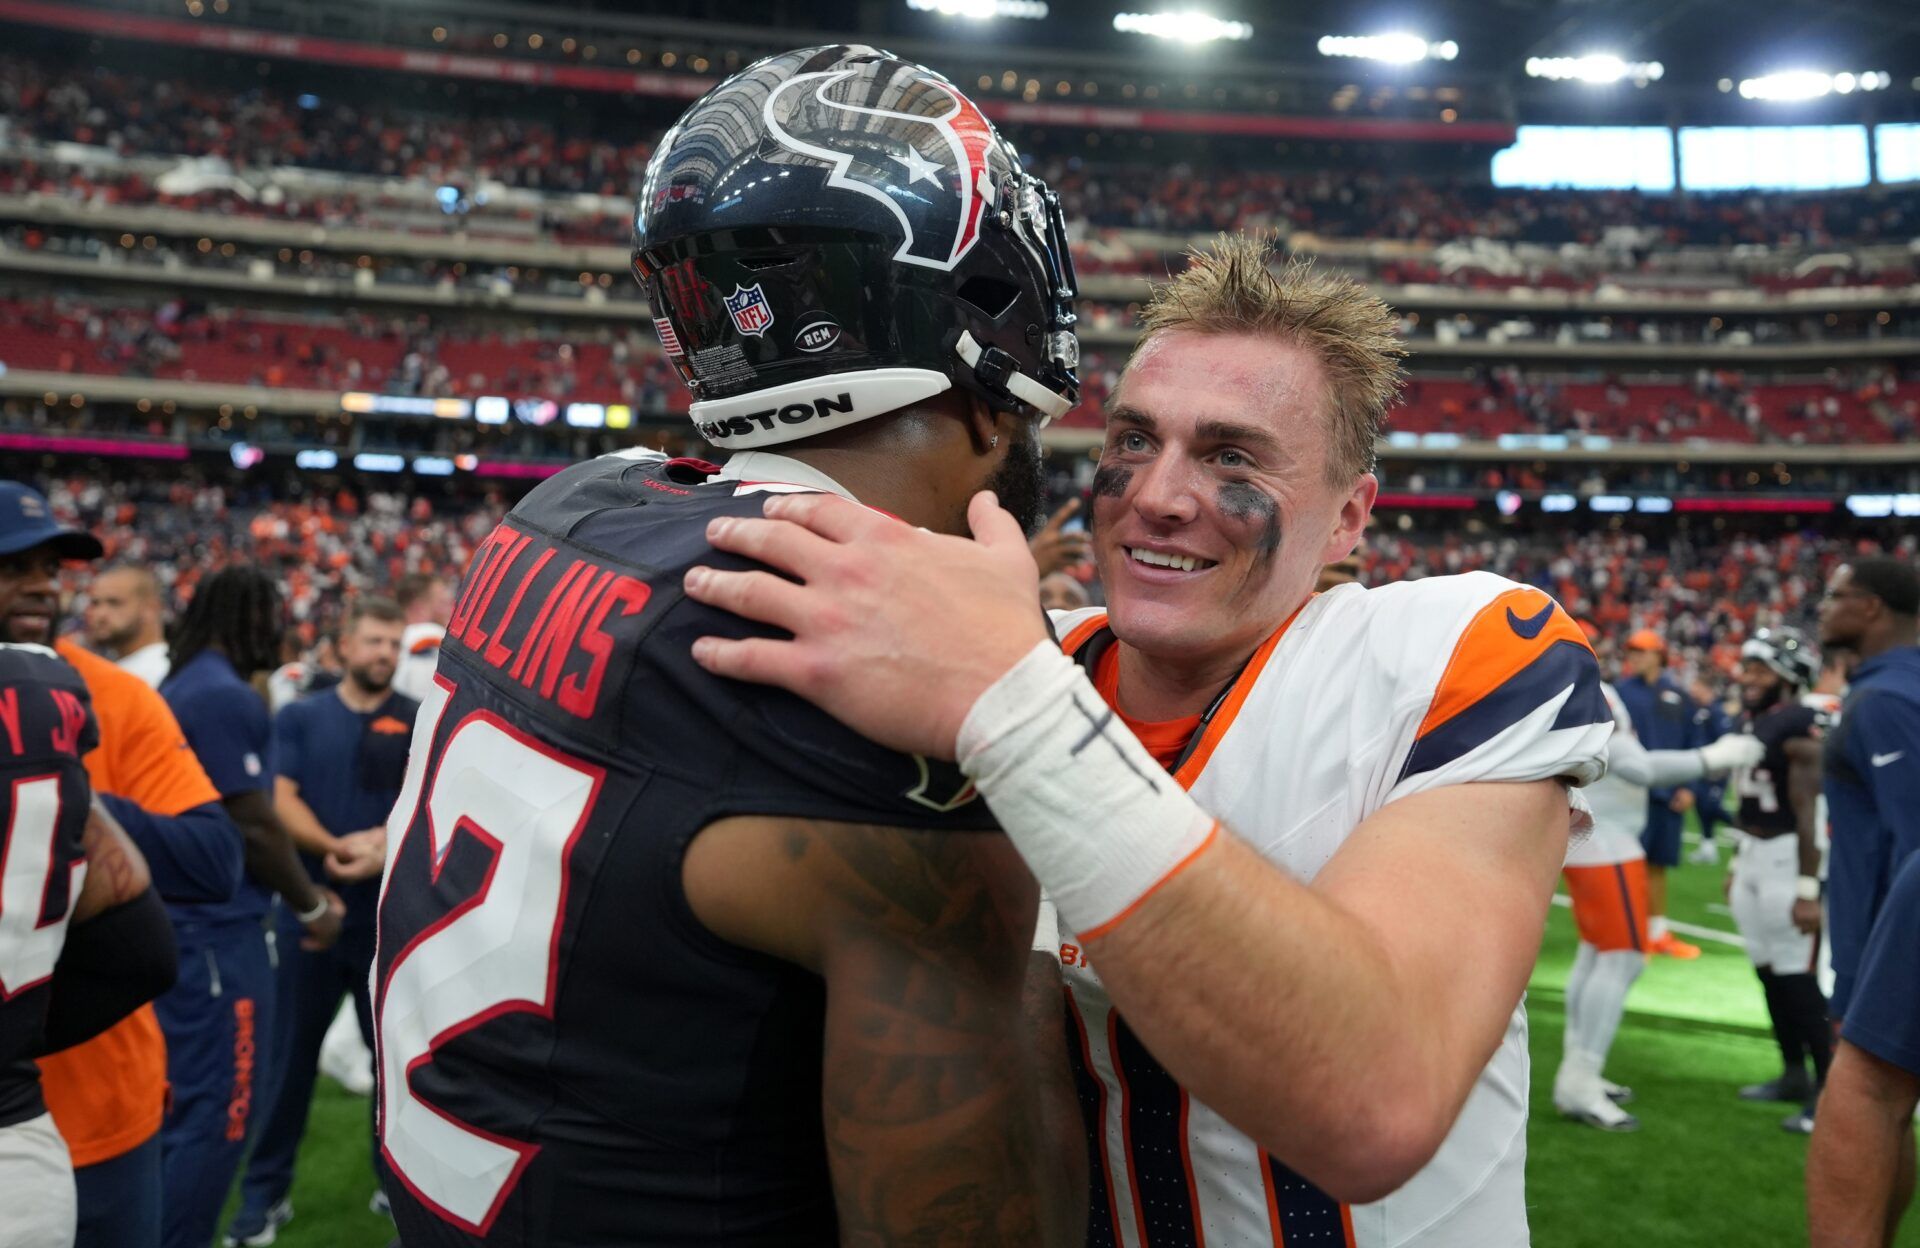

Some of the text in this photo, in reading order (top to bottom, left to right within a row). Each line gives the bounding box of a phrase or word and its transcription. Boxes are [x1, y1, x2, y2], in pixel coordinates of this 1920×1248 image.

[736, 304, 769, 330] NFL
[803, 327, 832, 347] RCM
[224, 997, 255, 1142] BRONCOS
